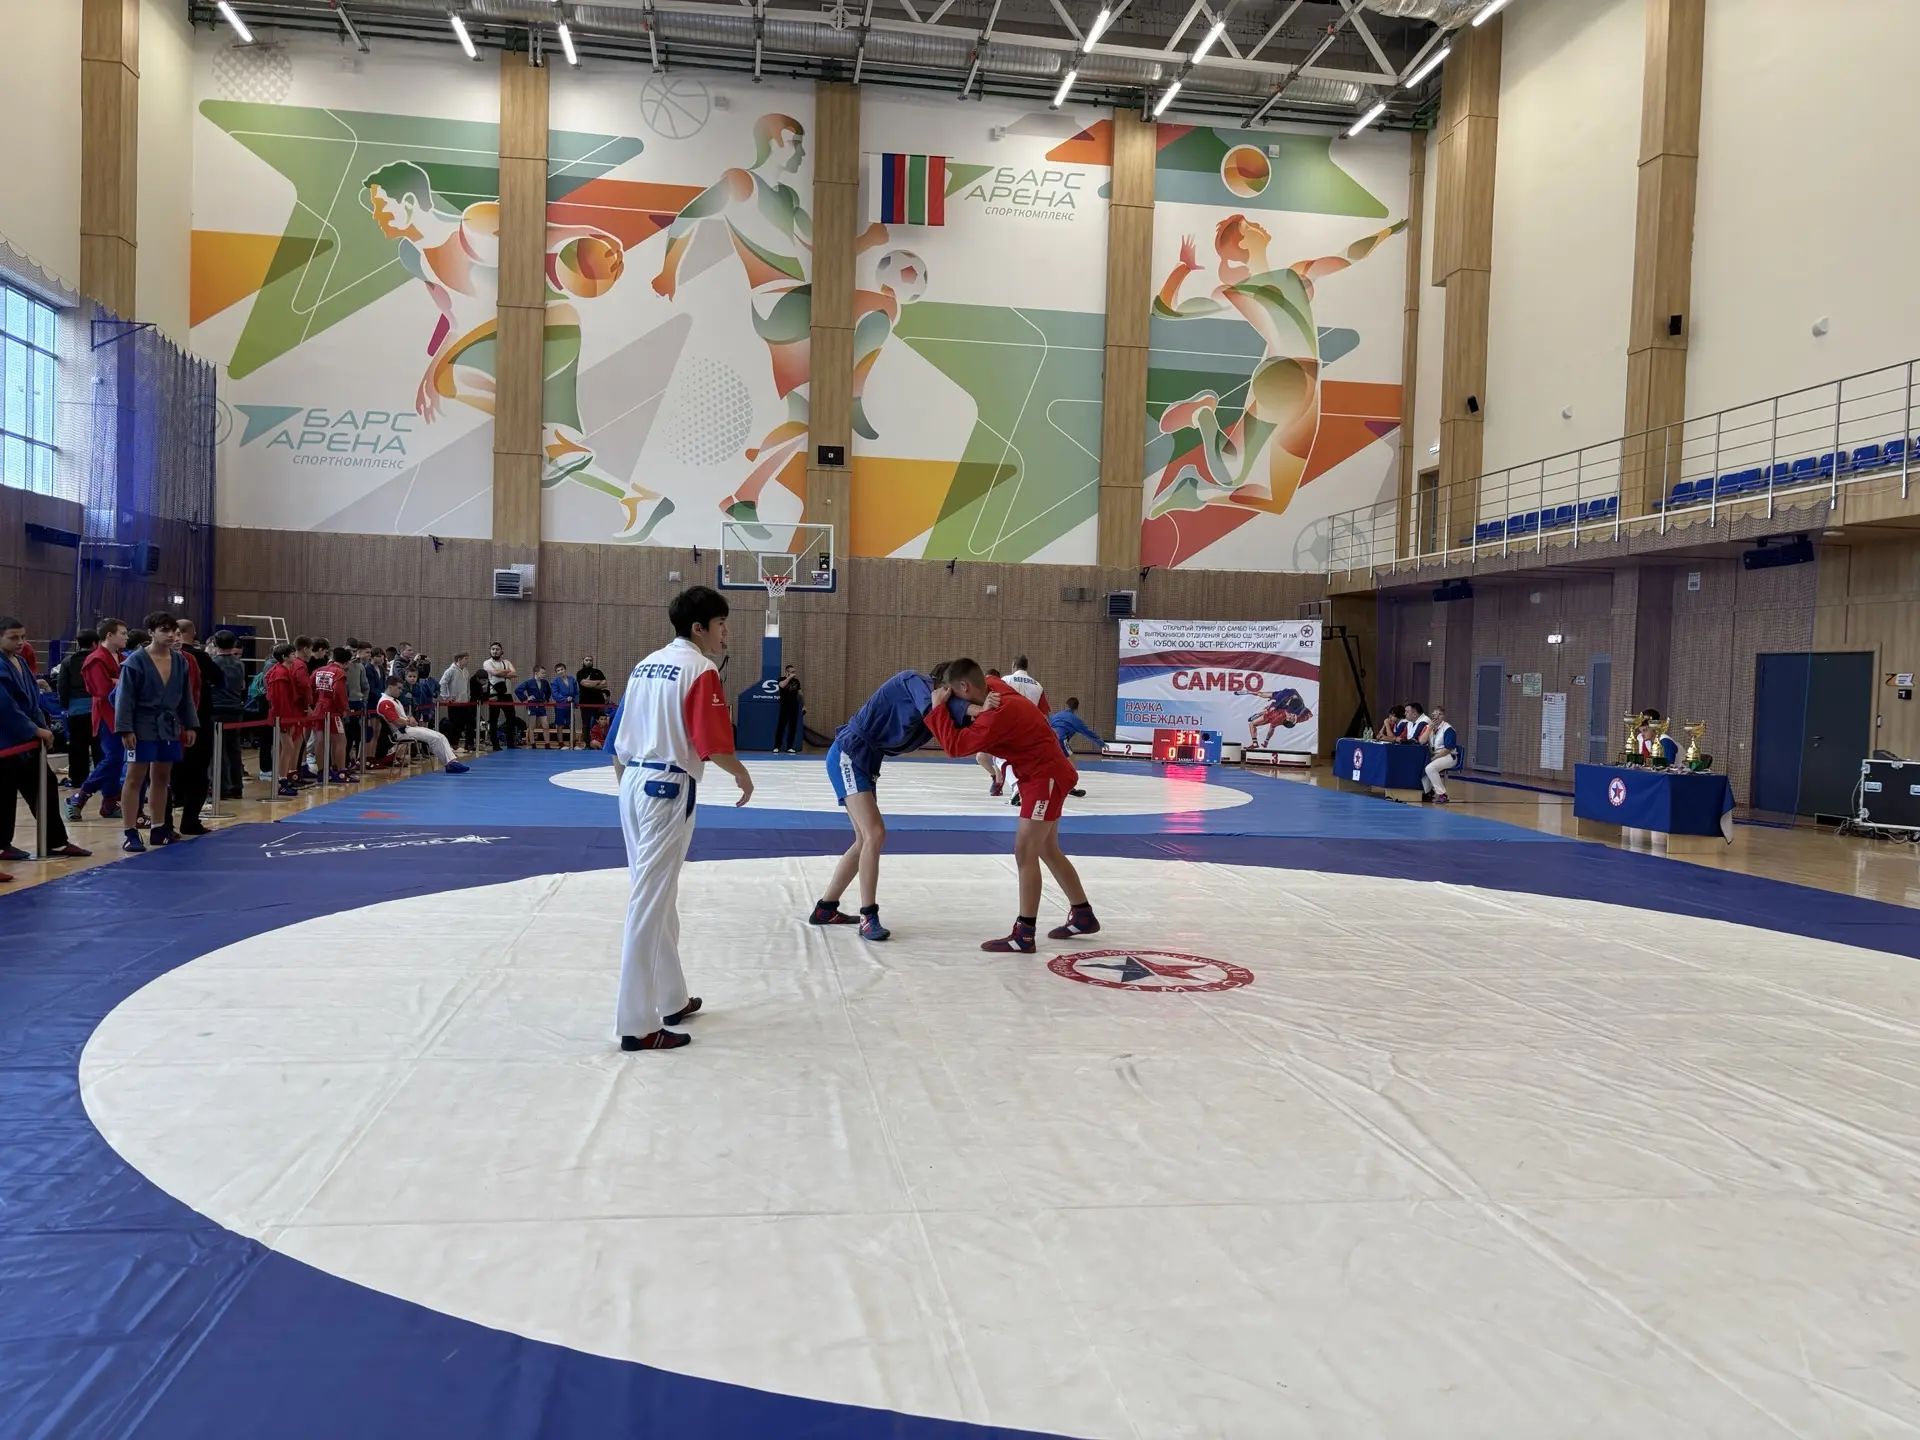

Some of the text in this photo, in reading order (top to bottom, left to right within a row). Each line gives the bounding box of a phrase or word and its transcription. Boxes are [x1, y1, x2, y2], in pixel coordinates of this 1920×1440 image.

[994, 167, 1085, 189] БАРС
[964, 185, 1076, 209] АРЕНА
[985, 206, 1075, 221] СПОРТКОМПЛЕКС
[304, 408, 418, 432] БАРС
[266, 429, 406, 455] АРЕНА
[293, 455, 405, 469] СПОРТКОМПЛЕКС
[1153, 640, 1177, 648] КУБОК
[1178, 640, 1194, 648] ООО
[1172, 671, 1264, 692] САМБО
[1125, 701, 1163, 712] НАУКА
[1125, 711, 1204, 726] ПОБЕЖДАТЬ!
[1176, 732, 1200, 745] 3:17
[1125, 744, 1132, 755] 2
[1168, 747, 1176, 758] 0
[1197, 747, 1205, 760] 0
[1271, 753, 1279, 765] 3
